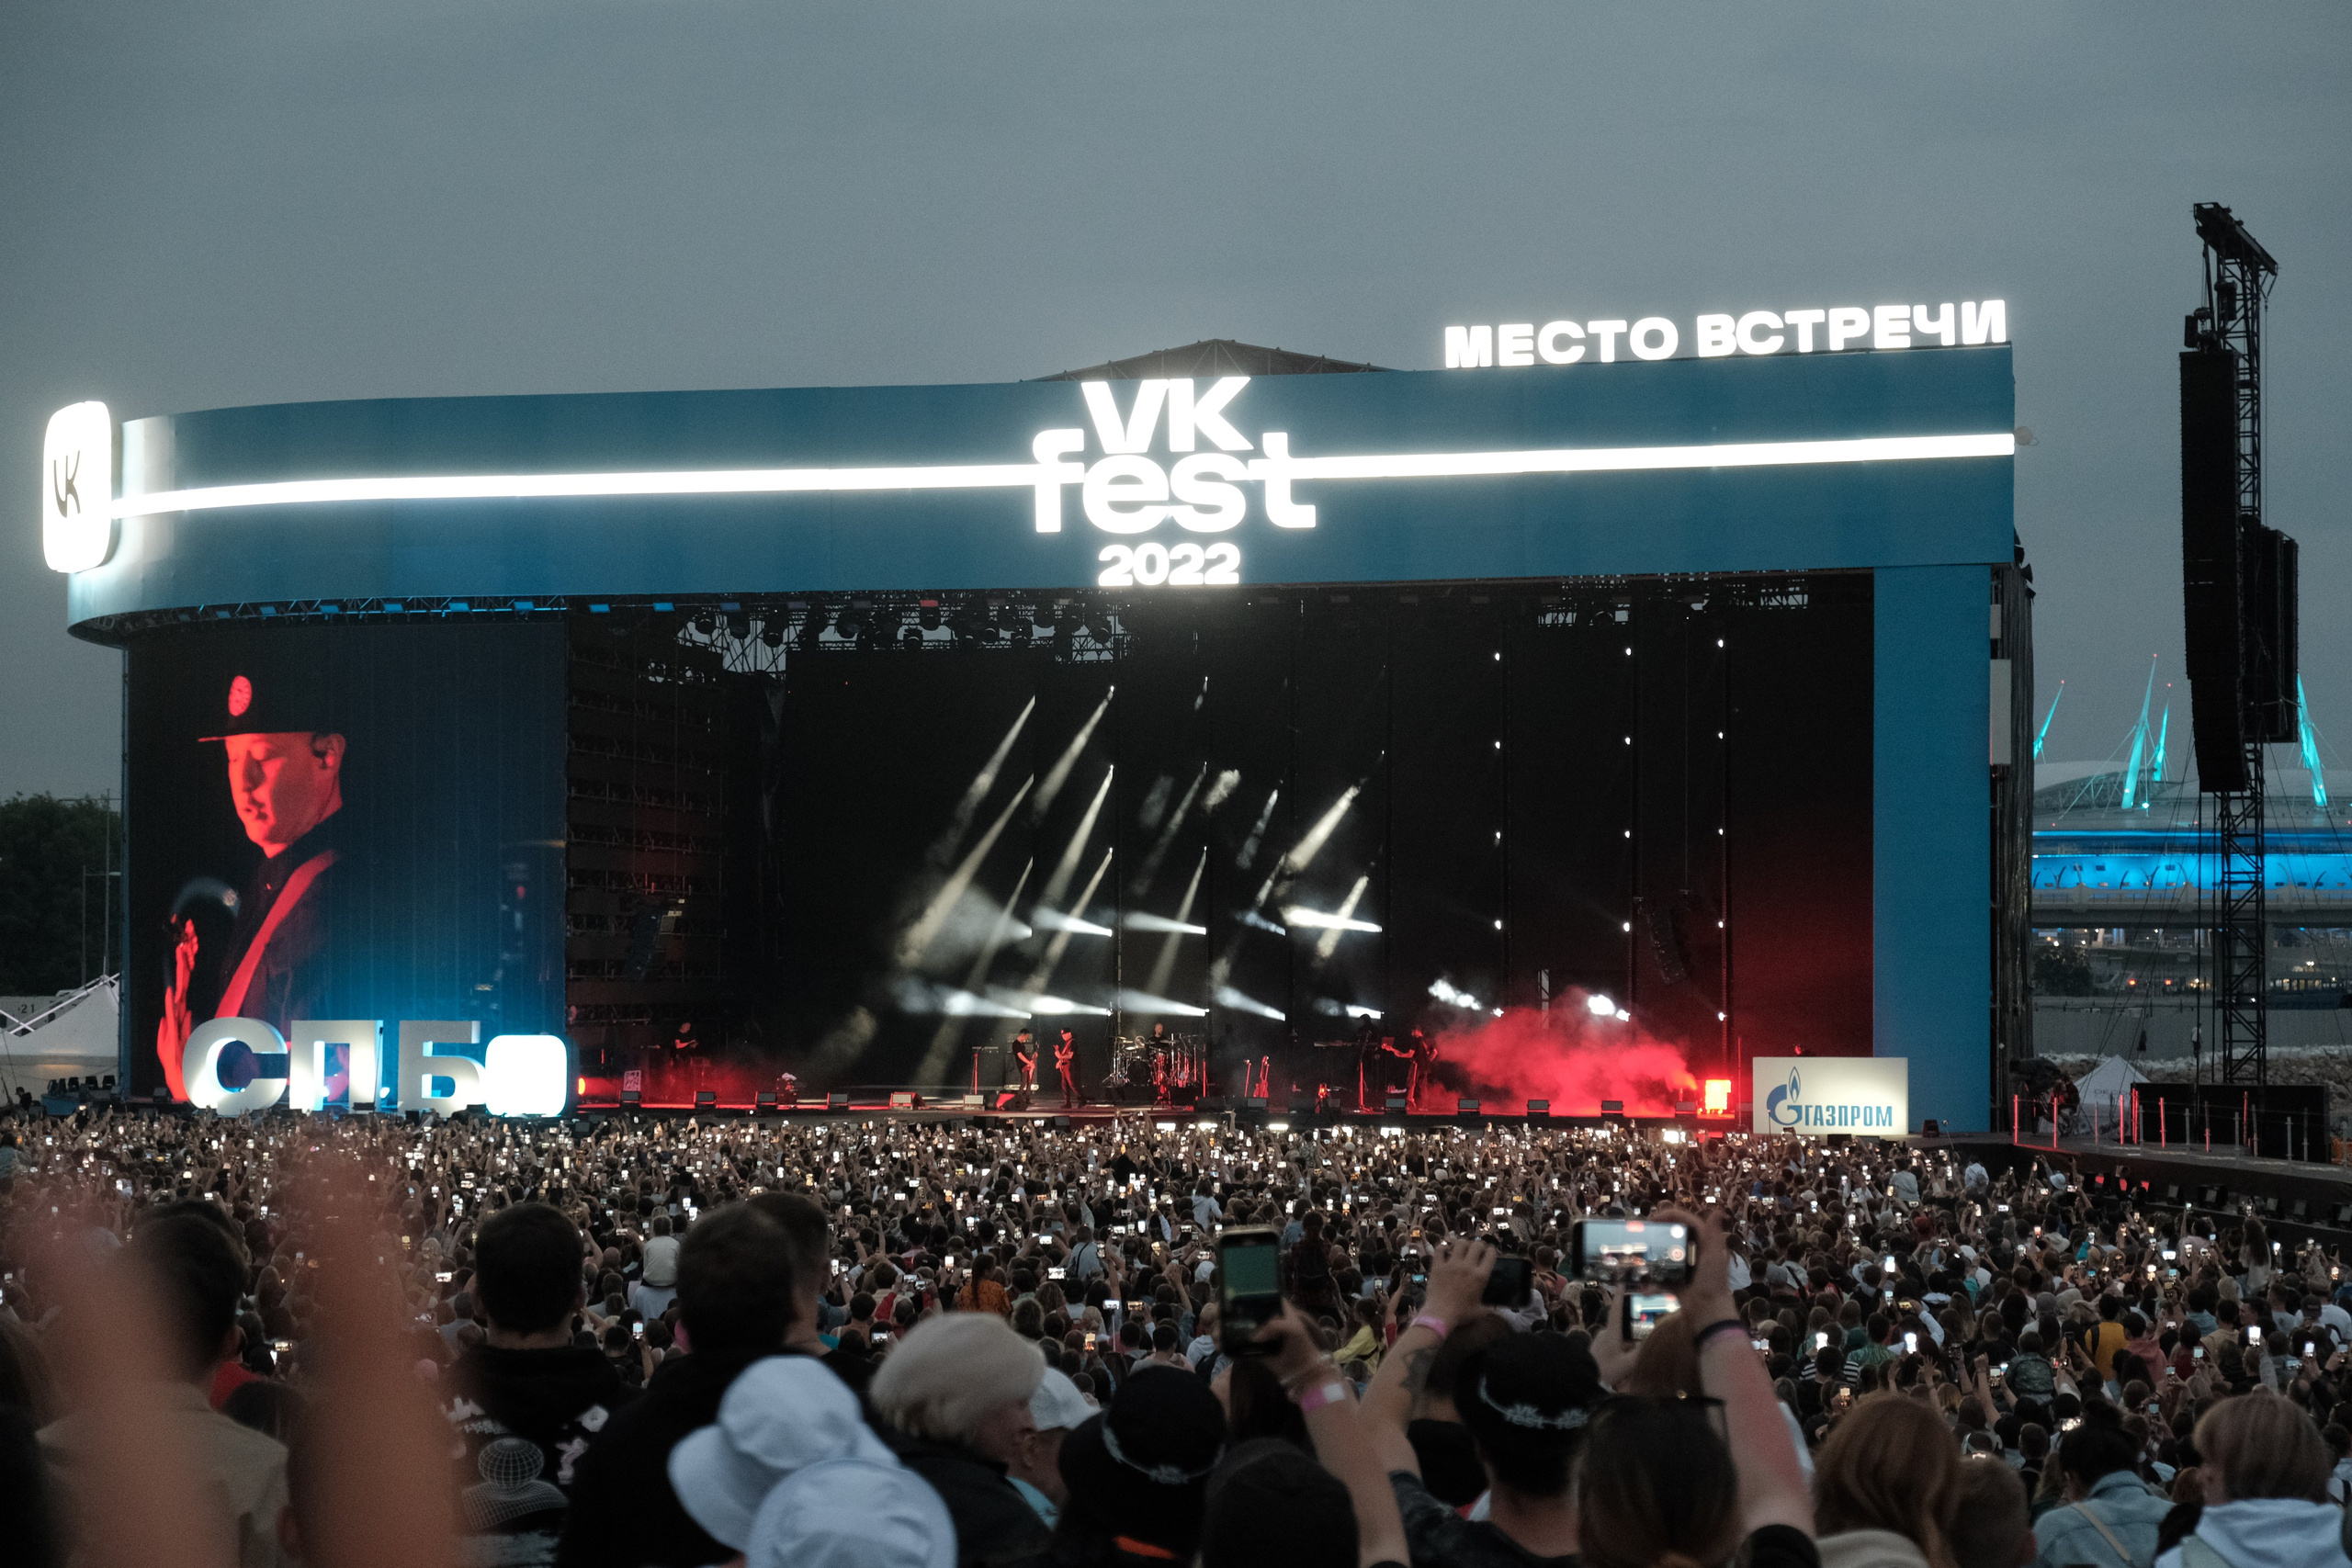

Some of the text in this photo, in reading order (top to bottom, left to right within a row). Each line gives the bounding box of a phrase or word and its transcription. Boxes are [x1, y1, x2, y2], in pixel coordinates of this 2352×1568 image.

[1444, 299, 2007, 368] МЕСТО ВСТРЕЧИ
[1080, 376, 1254, 455] VK
[1032, 428, 1317, 535] fest
[1098, 542, 1241, 587] 2022
[183, 1017, 487, 1117] СПБ
[1805, 1105, 1893, 1127] ГАЗПРОМ
